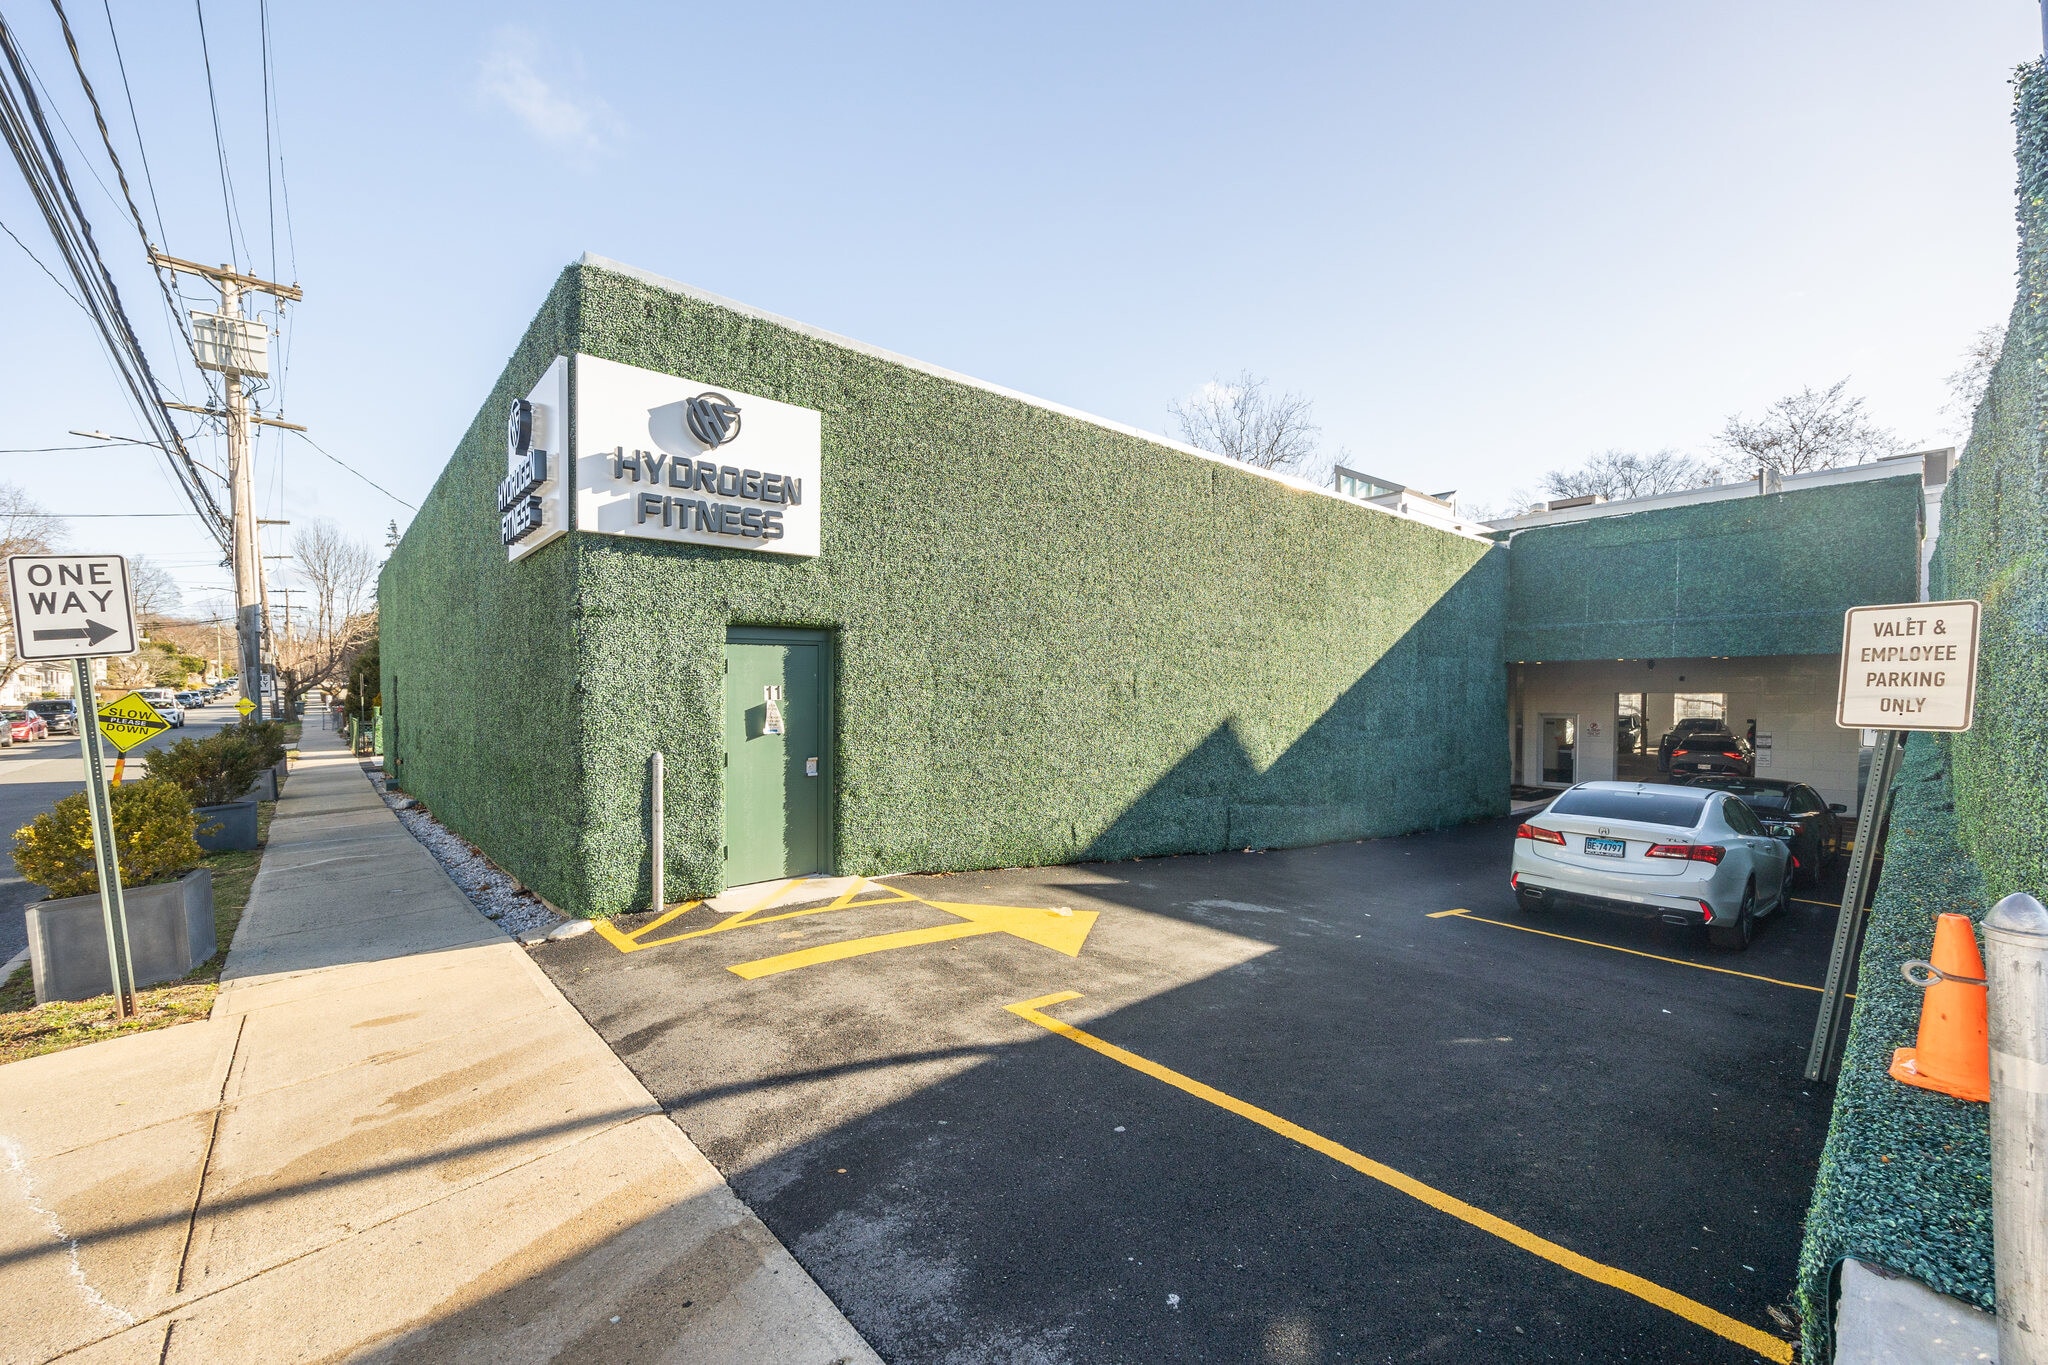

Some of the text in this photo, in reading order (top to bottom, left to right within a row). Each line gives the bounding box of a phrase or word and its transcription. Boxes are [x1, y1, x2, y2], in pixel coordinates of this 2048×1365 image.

[498, 449, 543, 512] HYDROGEN
[614, 446, 802, 506] HYDROGEN
[501, 494, 538, 545] FITNESS
[637, 492, 784, 539] FITNESS
[27, 563, 112, 587] ONE
[28, 590, 114, 615] WAY
[1873, 619, 1947, 638] VALET &
[1860, 645, 1957, 663] EMPLOYEE
[1866, 671, 1946, 688] PARKING
[766, 685, 781, 700] 11
[108, 707, 153, 720] SLOW
[1879, 697, 1927, 713] ONLY
[106, 723, 149, 735] DOWN
[110, 717, 147, 727] PLEASE
